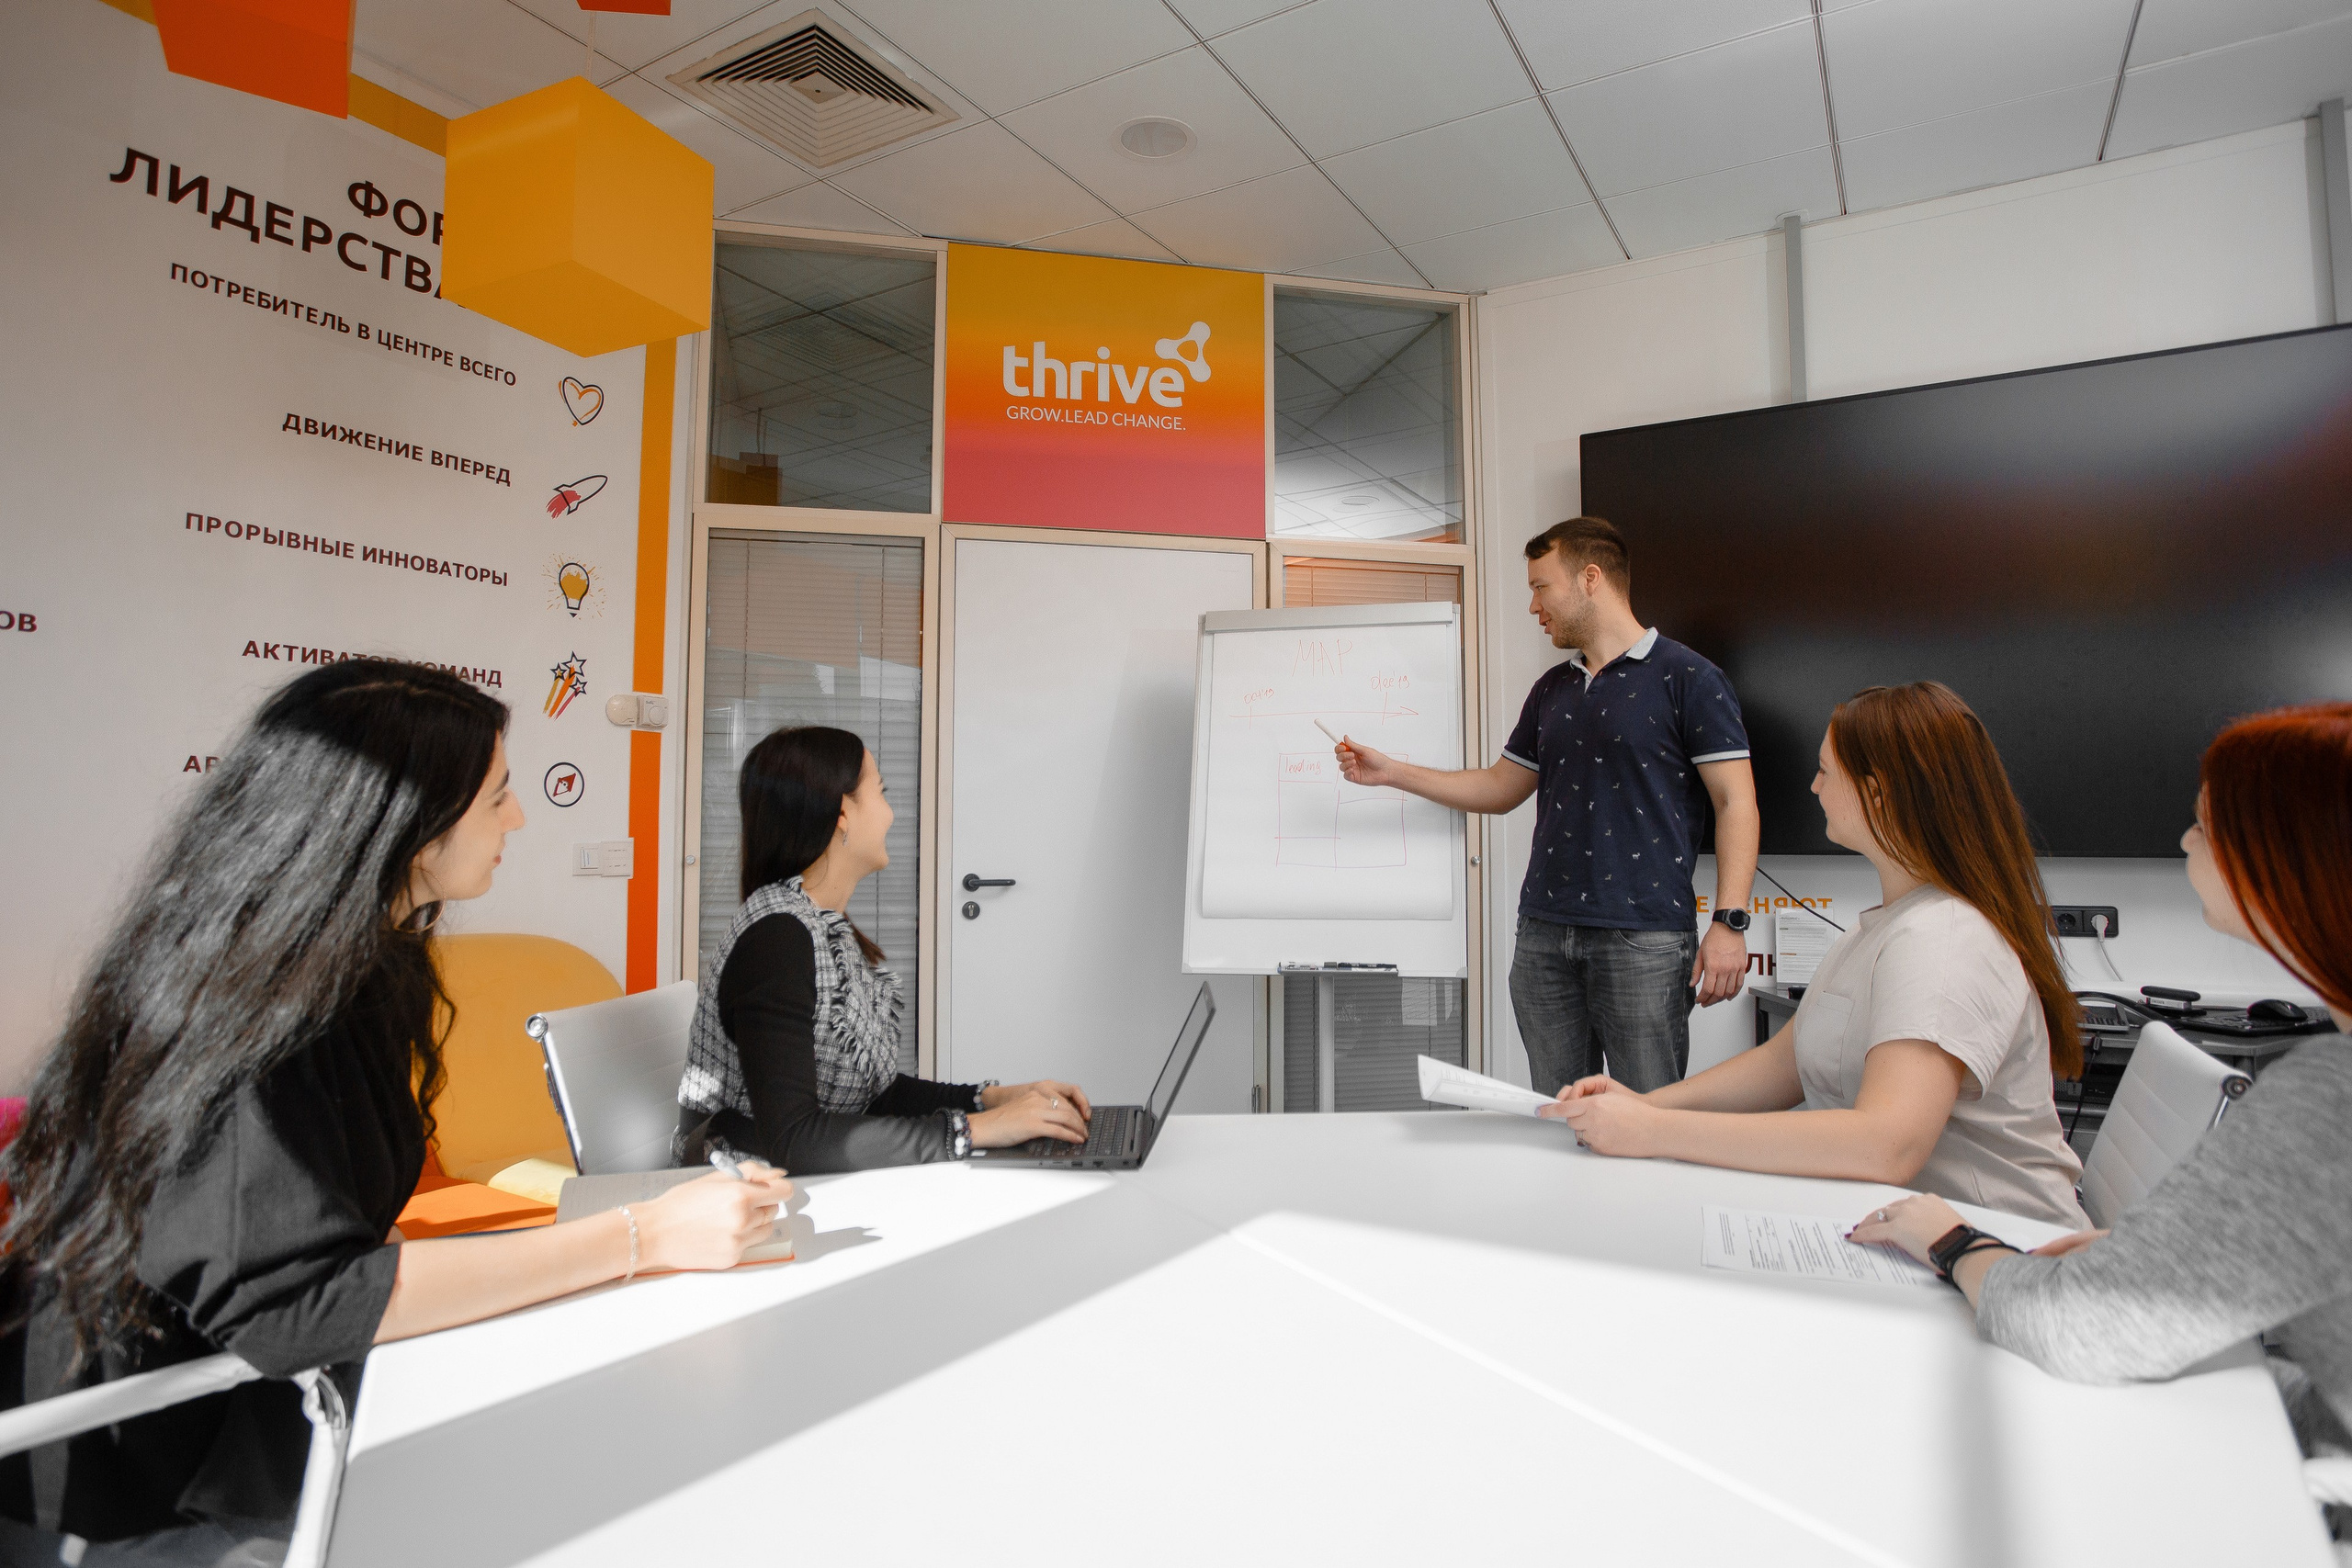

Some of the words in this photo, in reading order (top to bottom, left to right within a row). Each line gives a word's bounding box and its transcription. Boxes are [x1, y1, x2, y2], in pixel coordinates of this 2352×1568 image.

[109, 147, 465, 309] ЛИДЕРСТВ
[171, 262, 351, 333] ПОТРЕБИТЕЛЬ
[357, 322, 370, 341] В
[378, 329, 454, 367] ЦЕНТРЕ
[459, 355, 516, 387] ВСЕГО
[1003, 341, 1185, 408] thrive
[282, 412, 424, 462] ДВИЖЕНИЕ
[430, 449, 512, 487] ВПЕРЕД
[1112, 412, 1186, 431] CHANGE.
[186, 512, 355, 559] ПРОРЫВНЫЕ
[362, 546, 508, 587] ИННОВАТОРЫ
[1292, 638, 1353, 677] MAP
